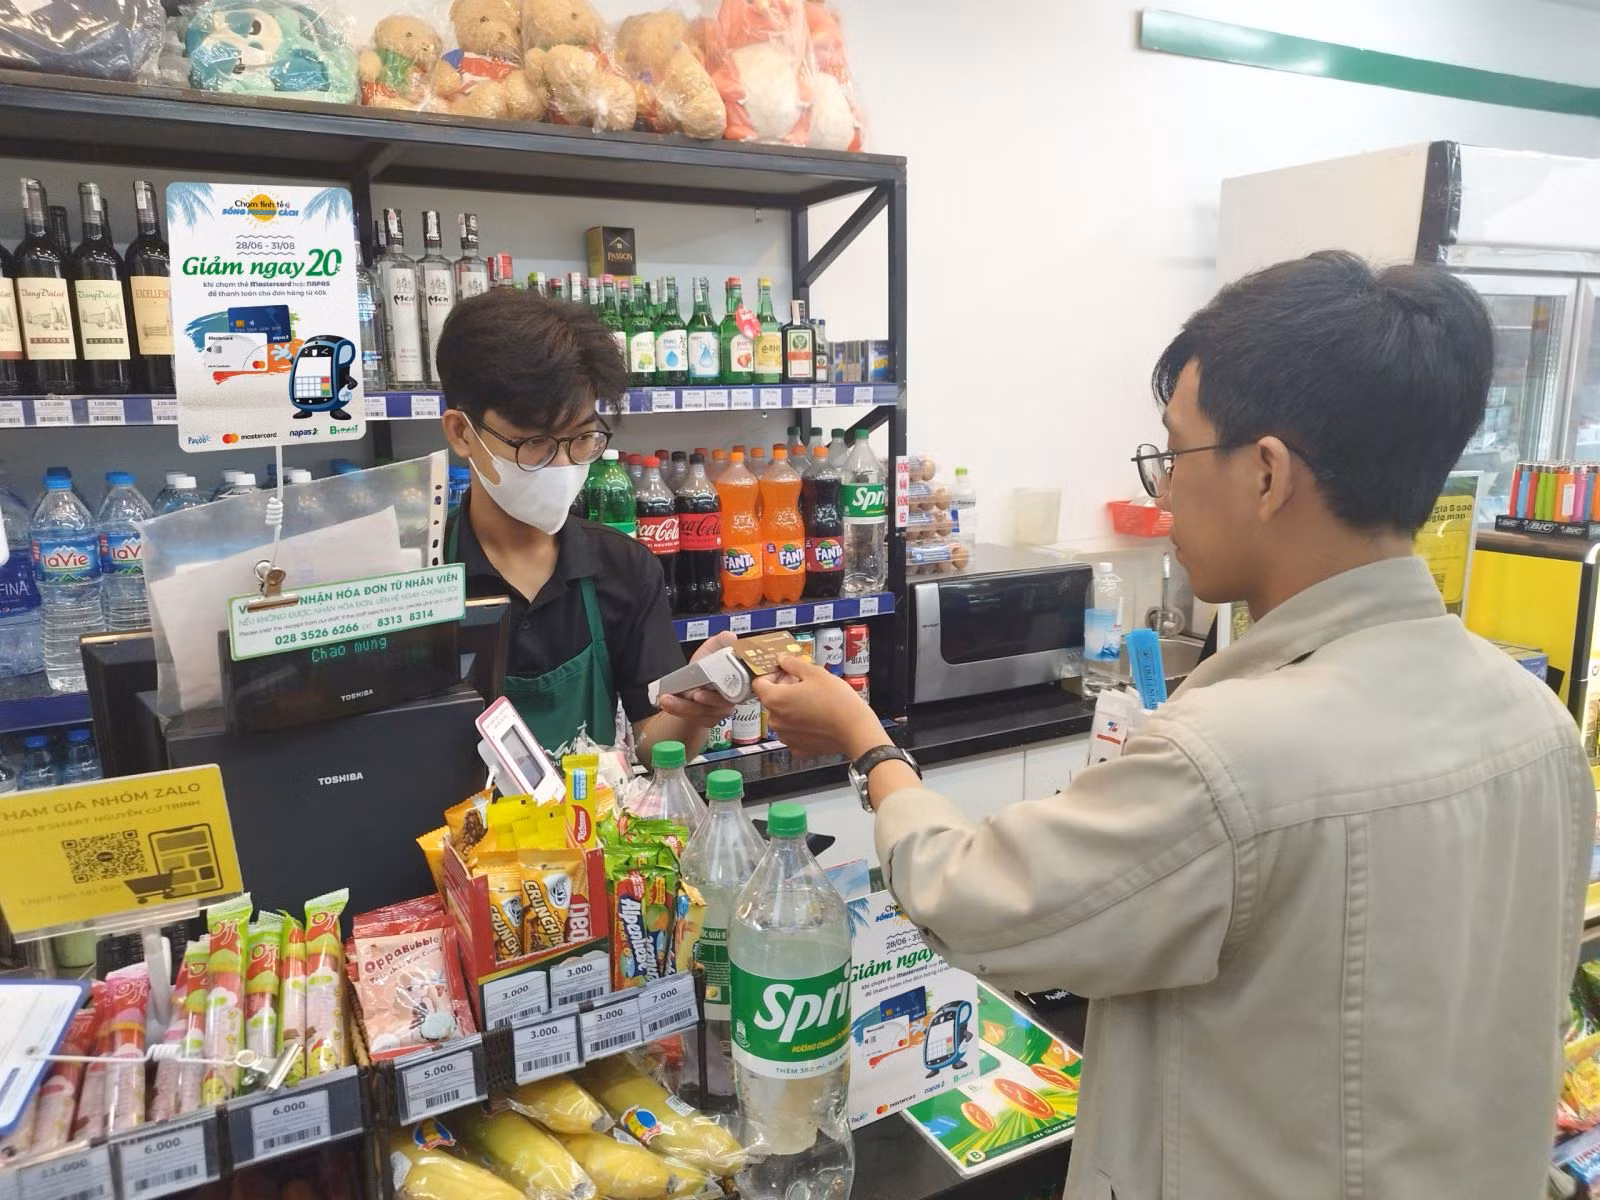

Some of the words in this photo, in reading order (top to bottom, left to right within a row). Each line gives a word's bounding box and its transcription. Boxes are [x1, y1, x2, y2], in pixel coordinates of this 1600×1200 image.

[236, 241, 263, 250] 28/06
[271, 241, 295, 250] 31/08
[607, 252, 633, 262] PASSION
[182, 256, 247, 276] Giảm
[249, 261, 305, 279] ngay
[241, 289, 257, 297] toán
[258, 289, 271, 297] cho
[286, 288, 304, 297] hàng
[313, 288, 327, 296] 40k
[240, 433, 277, 441] mastercard
[289, 429, 312, 438] napas
[1530, 523, 1552, 533] BIC
[723, 553, 755, 569] FANTA
[815, 545, 842, 563] FANT
[300, 592, 332, 605] NHẬN
[337, 587, 360, 599] HÓA
[364, 583, 387, 596] ĐƠN
[405, 577, 433, 589] NHÂN
[436, 572, 458, 584] VIÊN
[275, 633, 297, 645] 028
[301, 628, 329, 641] 3526
[332, 622, 359, 636] 6266
[377, 615, 402, 627] 8313
[409, 609, 434, 621] 8314
[312, 645, 346, 661] Chao
[354, 637, 387, 653] mung
[340, 688, 374, 702] TOSHIBA
[318, 772, 364, 786] TOSHIBA
[53, 800, 86, 814] GIA
[91, 791, 148, 808] NHÓM
[154, 783, 201, 798] ZALO
[165, 800, 201, 811] TRINH
[886, 937, 907, 950] 28/06
[897, 948, 935, 969] ngay
[567, 964, 593, 977] 3.000
[896, 965, 928, 978] Mastercard
[902, 978, 913, 986] cho
[502, 985, 529, 1000] 3.000
[652, 988, 678, 1003] 7.000
[597, 1008, 623, 1022] 3.000
[530, 1025, 558, 1040] 3.000
[424, 1063, 454, 1080] 5.000
[272, 1101, 306, 1116] 6.000
[144, 1137, 181, 1155] 6.000
[971, 1151, 982, 1160] B
